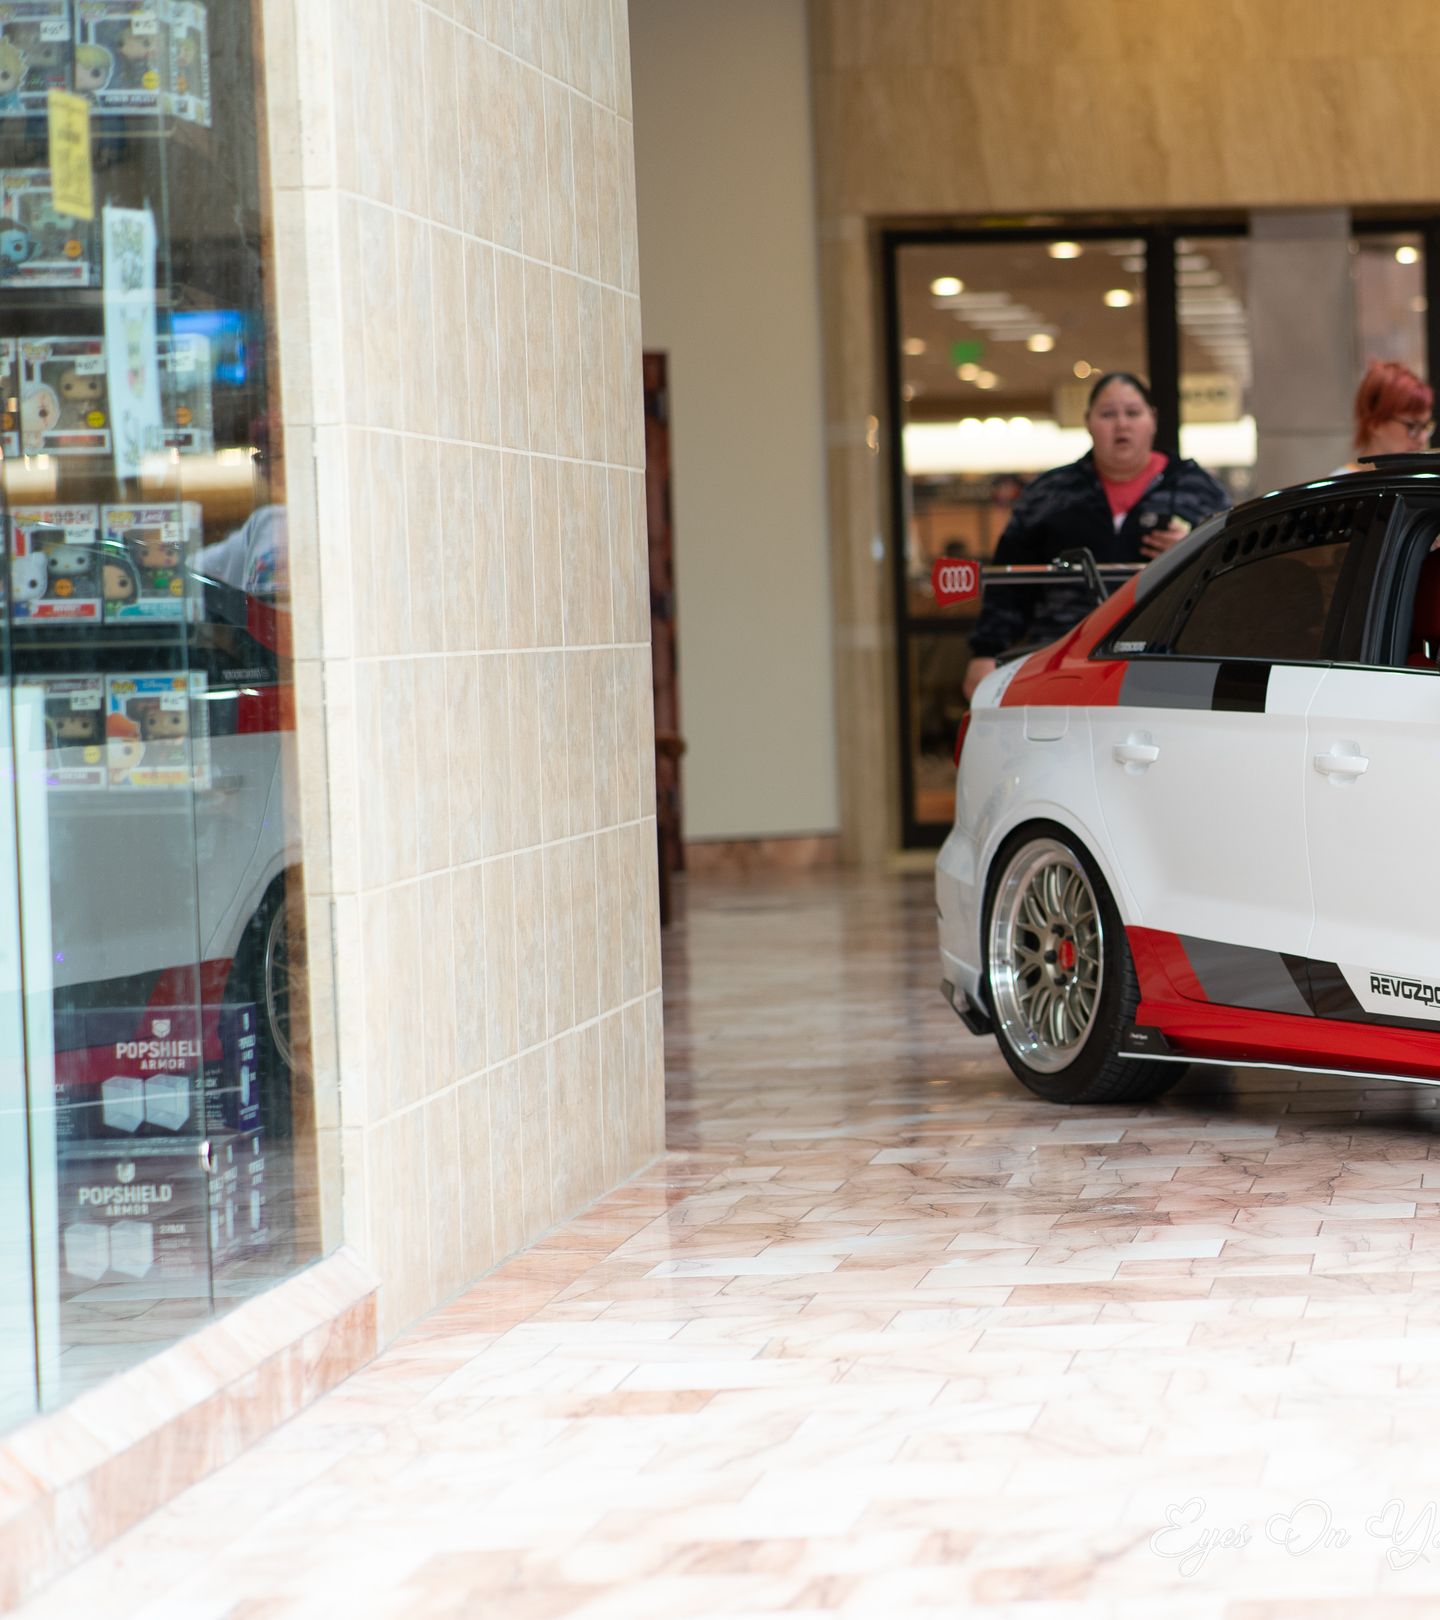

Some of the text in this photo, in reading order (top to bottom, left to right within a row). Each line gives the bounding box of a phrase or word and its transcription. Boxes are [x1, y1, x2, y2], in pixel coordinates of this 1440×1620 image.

[140, 1058, 186, 1070] ARMOR
[79, 1185, 172, 1205] POPSHIELD
[106, 1204, 149, 1216] ARMOR
